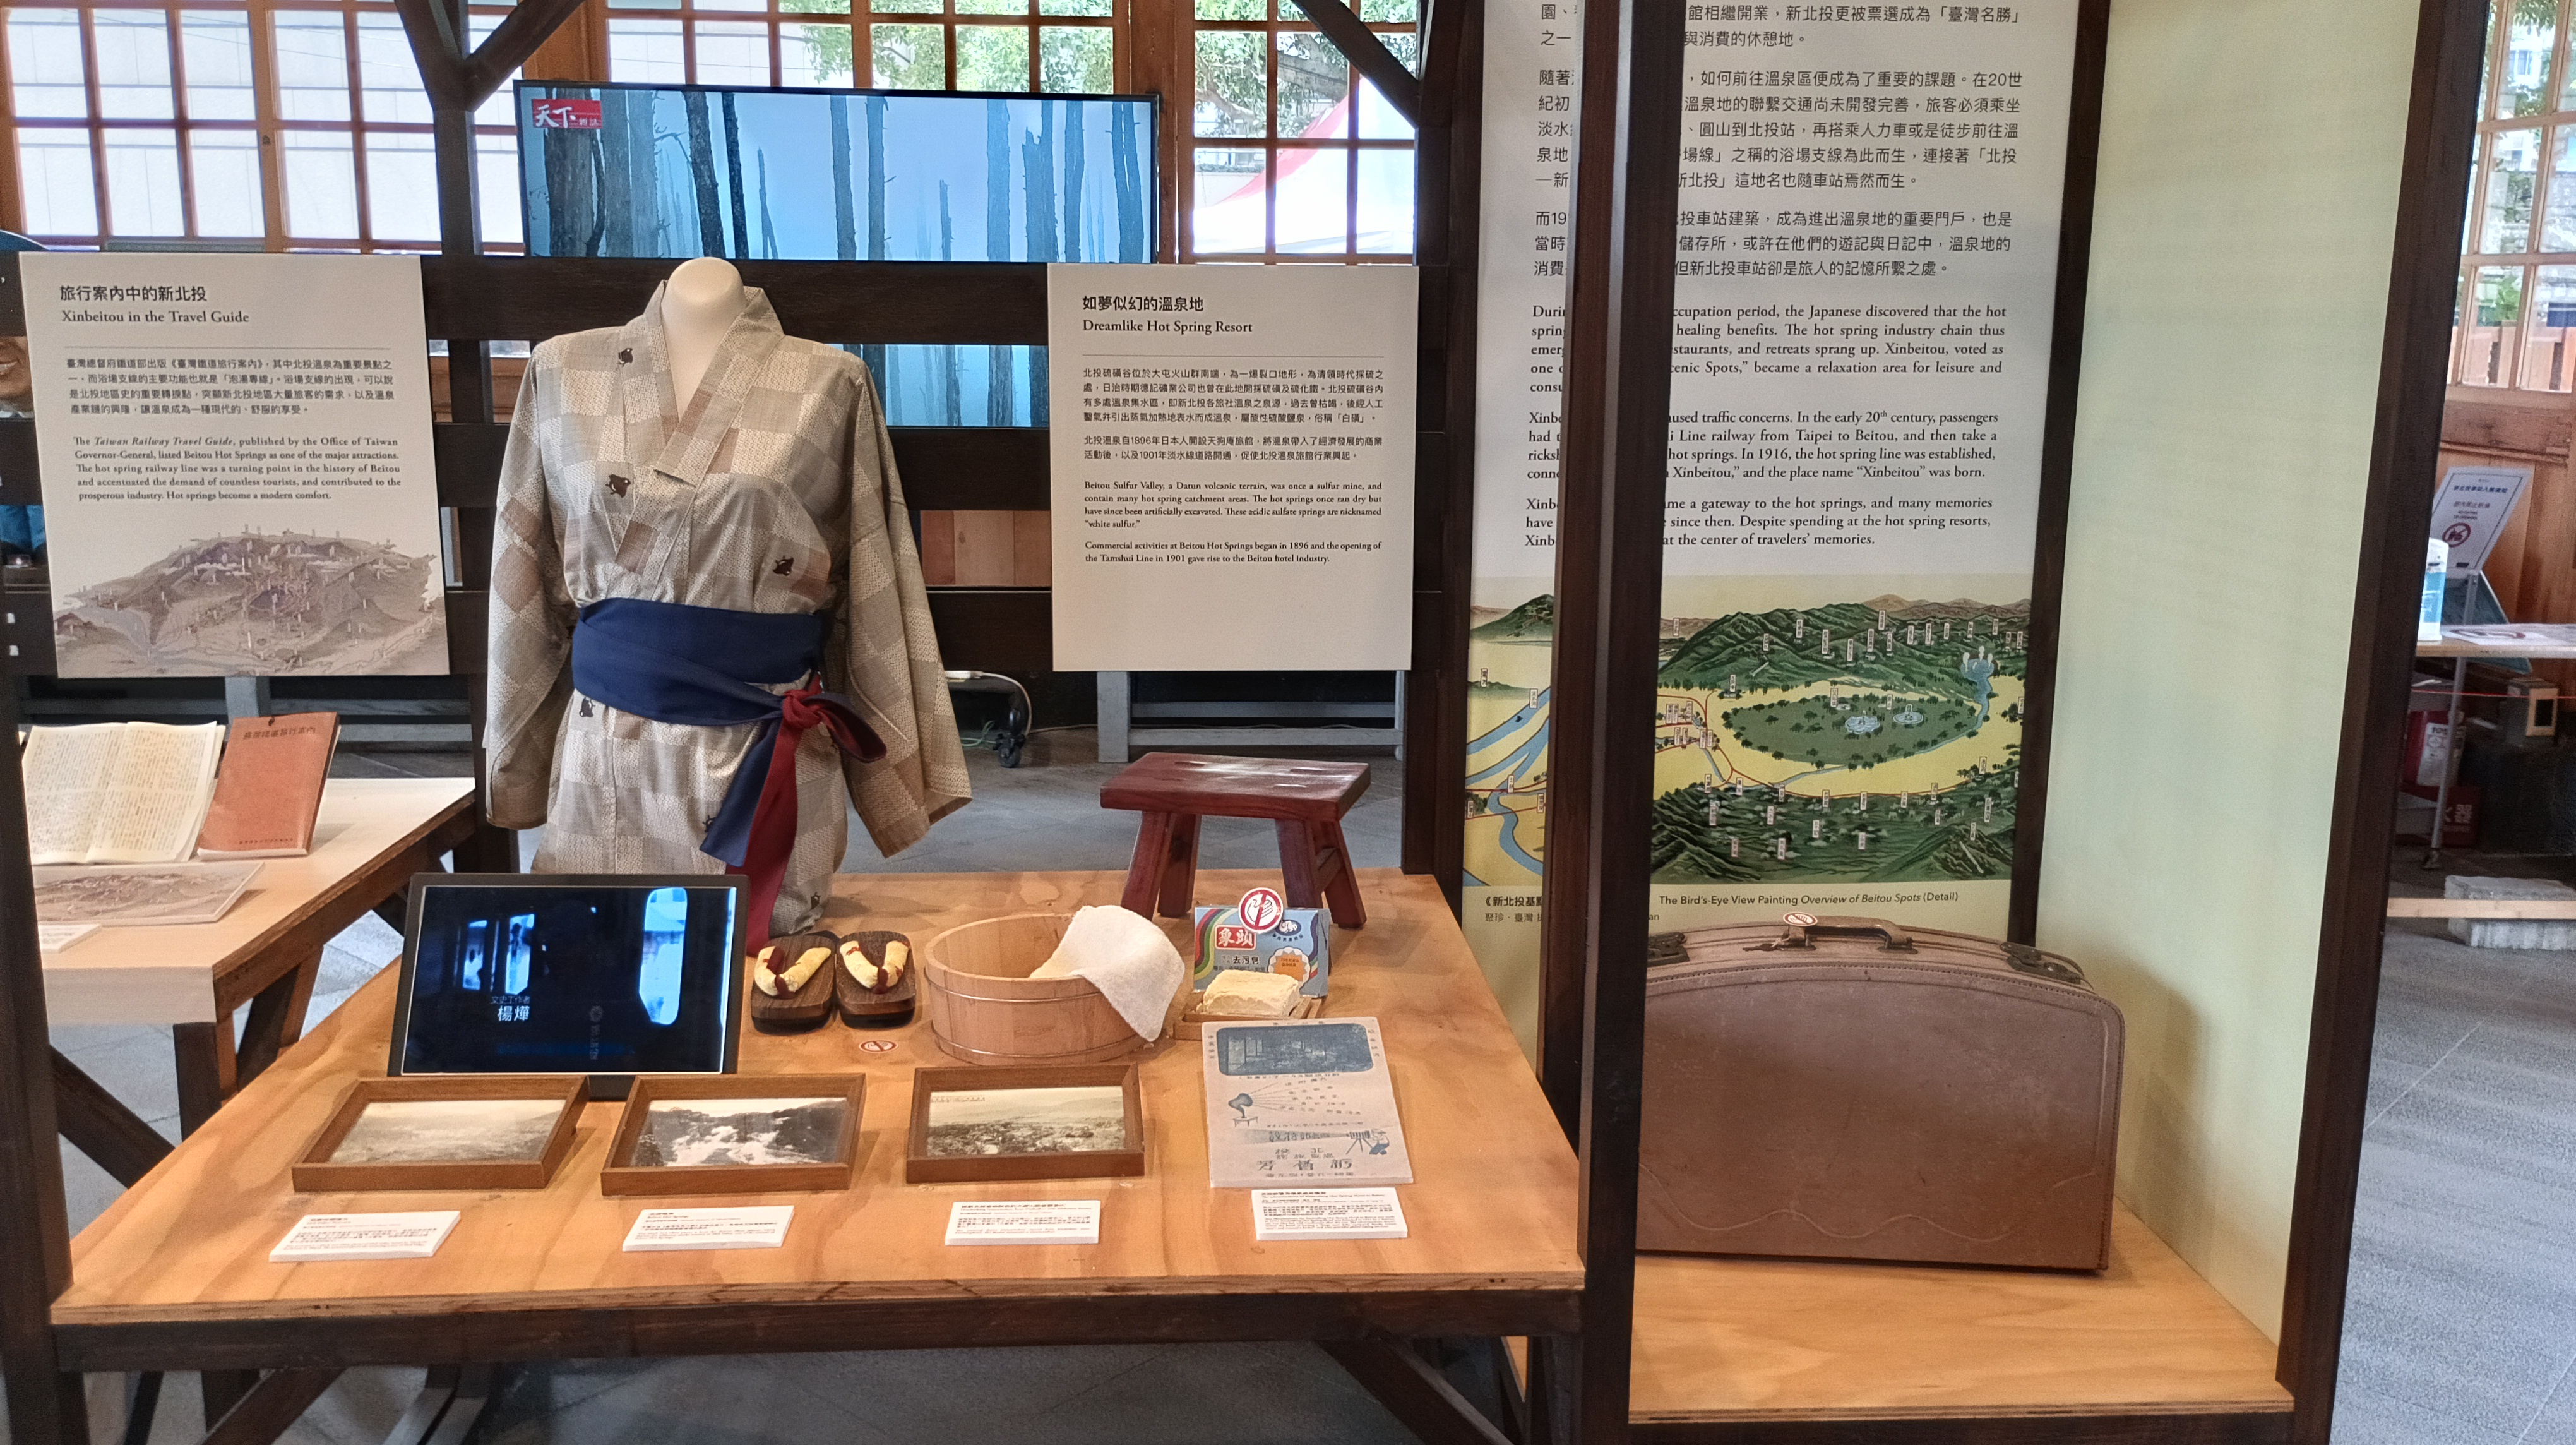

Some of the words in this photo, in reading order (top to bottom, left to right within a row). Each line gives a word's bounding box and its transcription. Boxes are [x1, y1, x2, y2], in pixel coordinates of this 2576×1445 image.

[1540, 29, 1571, 46] 之一
[1538, 95, 1570, 111] 紀初
[1537, 120, 1571, 137] 淡水
[1536, 146, 1568, 163] 泉地
[1682, 146, 2017, 164] 場線」之稱的浴場支線為此而生，連接著「北投
[1679, 210, 2012, 227] 投車站建築，成為進出溫泉地的重要門戶，也是
[59, 285, 207, 302] 旅行案內中的新北投
[1082, 295, 1204, 312] 如夢似幻的溫泉地
[61, 310, 124, 322] Xinbeitou
[128, 311, 141, 322] in
[144, 310, 165, 323] the
[167, 310, 206, 323] Travel
[210, 311, 249, 323] Guide
[1736, 304, 1780, 321] period,
[1785, 304, 1804, 317] the
[1807, 304, 1861, 321] Japanese
[1865, 304, 1928, 317] discovered
[1933, 304, 1958, 317] that
[1962, 304, 1981, 317] the
[1986, 304, 2007, 317] hot
[1083, 319, 1143, 332] Dreamlike
[1147, 320, 1171, 332] Hot
[1173, 320, 1212, 335] Spring
[1215, 320, 1252, 332] Resort
[1676, 323, 1721, 339] healing
[1727, 322, 1777, 336] benefits.
[1784, 323, 1808, 335] The
[1813, 323, 1834, 335] hot
[1840, 324, 1878, 340] spring
[1883, 323, 1935, 340] industry
[1940, 323, 1972, 335] chain
[1979, 323, 2005, 336] thus
[1704, 360, 1748, 377] Spots,”
[1753, 360, 1800, 373] became
[1804, 364, 1811, 373] a
[1817, 360, 1877, 373] relaxation
[1882, 364, 1907, 373] area
[1912, 359, 1931, 373] for
[1935, 360, 1974, 373] leisure
[1979, 360, 2002, 373] and
[1702, 410, 1736, 423] traffic
[1738, 414, 1793, 423] concerns.
[1797, 411, 1810, 423] In
[1813, 410, 1832, 423] the
[1834, 410, 1863, 426] early
[1890, 414, 1936, 426] century,
[1938, 414, 1998, 426] passengers
[1668, 447, 1688, 460] hot
[1691, 448, 1738, 464] springs.
[1741, 447, 1754, 459] In
[1758, 447, 1791, 461] 1916,
[1794, 447, 1813, 460] the
[1816, 447, 1837, 459] hot
[1839, 448, 1877, 464] spring
[1879, 447, 1902, 459] line
[1904, 451, 1926, 459] was
[1928, 447, 1995, 460] established,
[75, 463, 93, 472] The
[94, 463, 110, 472] hot
[113, 464, 143, 475] spring
[145, 462, 179, 475] railway
[180, 462, 198, 472] line
[229, 464, 264, 475] turning
[266, 464, 291, 475] point
[294, 464, 303, 472] in
[306, 463, 321, 472] the
[323, 463, 355, 475] history
[357, 463, 369, 473] of
[370, 464, 400, 473] Beitou
[1084, 481, 1111, 489] Beitou
[1113, 480, 1138, 489] Sulfur
[1140, 481, 1166, 492] Valley,
[1176, 481, 1202, 489] Datun
[1204, 481, 1236, 490] volcanic
[1239, 482, 1268, 491] terrain,
[1316, 481, 1340, 490] sulfur
[1342, 482, 1364, 491] mine,
[1367, 481, 1382, 490] and
[78, 493, 125, 501] prosperous
[126, 490, 164, 501] industry.
[165, 490, 184, 500] Hot
[186, 491, 217, 501] springs
[218, 490, 251, 500] become
[259, 489, 294, 500] modern
[294, 489, 332, 500] comfort.
[1085, 541, 1133, 549] Commercial
[1134, 541, 1168, 549] activities
[1179, 541, 1205, 549] Beitou
[1207, 541, 1222, 549] Hot
[1224, 541, 1253, 552] Springs
[1254, 541, 1277, 552] began
[1279, 541, 1287, 549] in
[1289, 541, 1309, 550] 1896
[1309, 541, 1325, 549] and
[1326, 541, 1339, 549] the
[1340, 542, 1372, 552] opening
[1373, 541, 1382, 549] of
[1662, 536, 1674, 545] at
[1678, 532, 1697, 545] the
[1700, 536, 1738, 545] center
[1741, 532, 1756, 545] of
[1757, 532, 1810, 545] travelers’
[1813, 533, 1875, 544] memories.
[1659, 895, 1678, 905] The
[1731, 895, 1756, 904] View
[1758, 894, 1798, 905] Painting
[1800, 894, 1847, 904] Overview
[1848, 894, 1860, 904] of
[1861, 894, 1892, 903] Beitou
[1893, 892, 1921, 904] Spots
[1923, 891, 1959, 902] (Detail)
